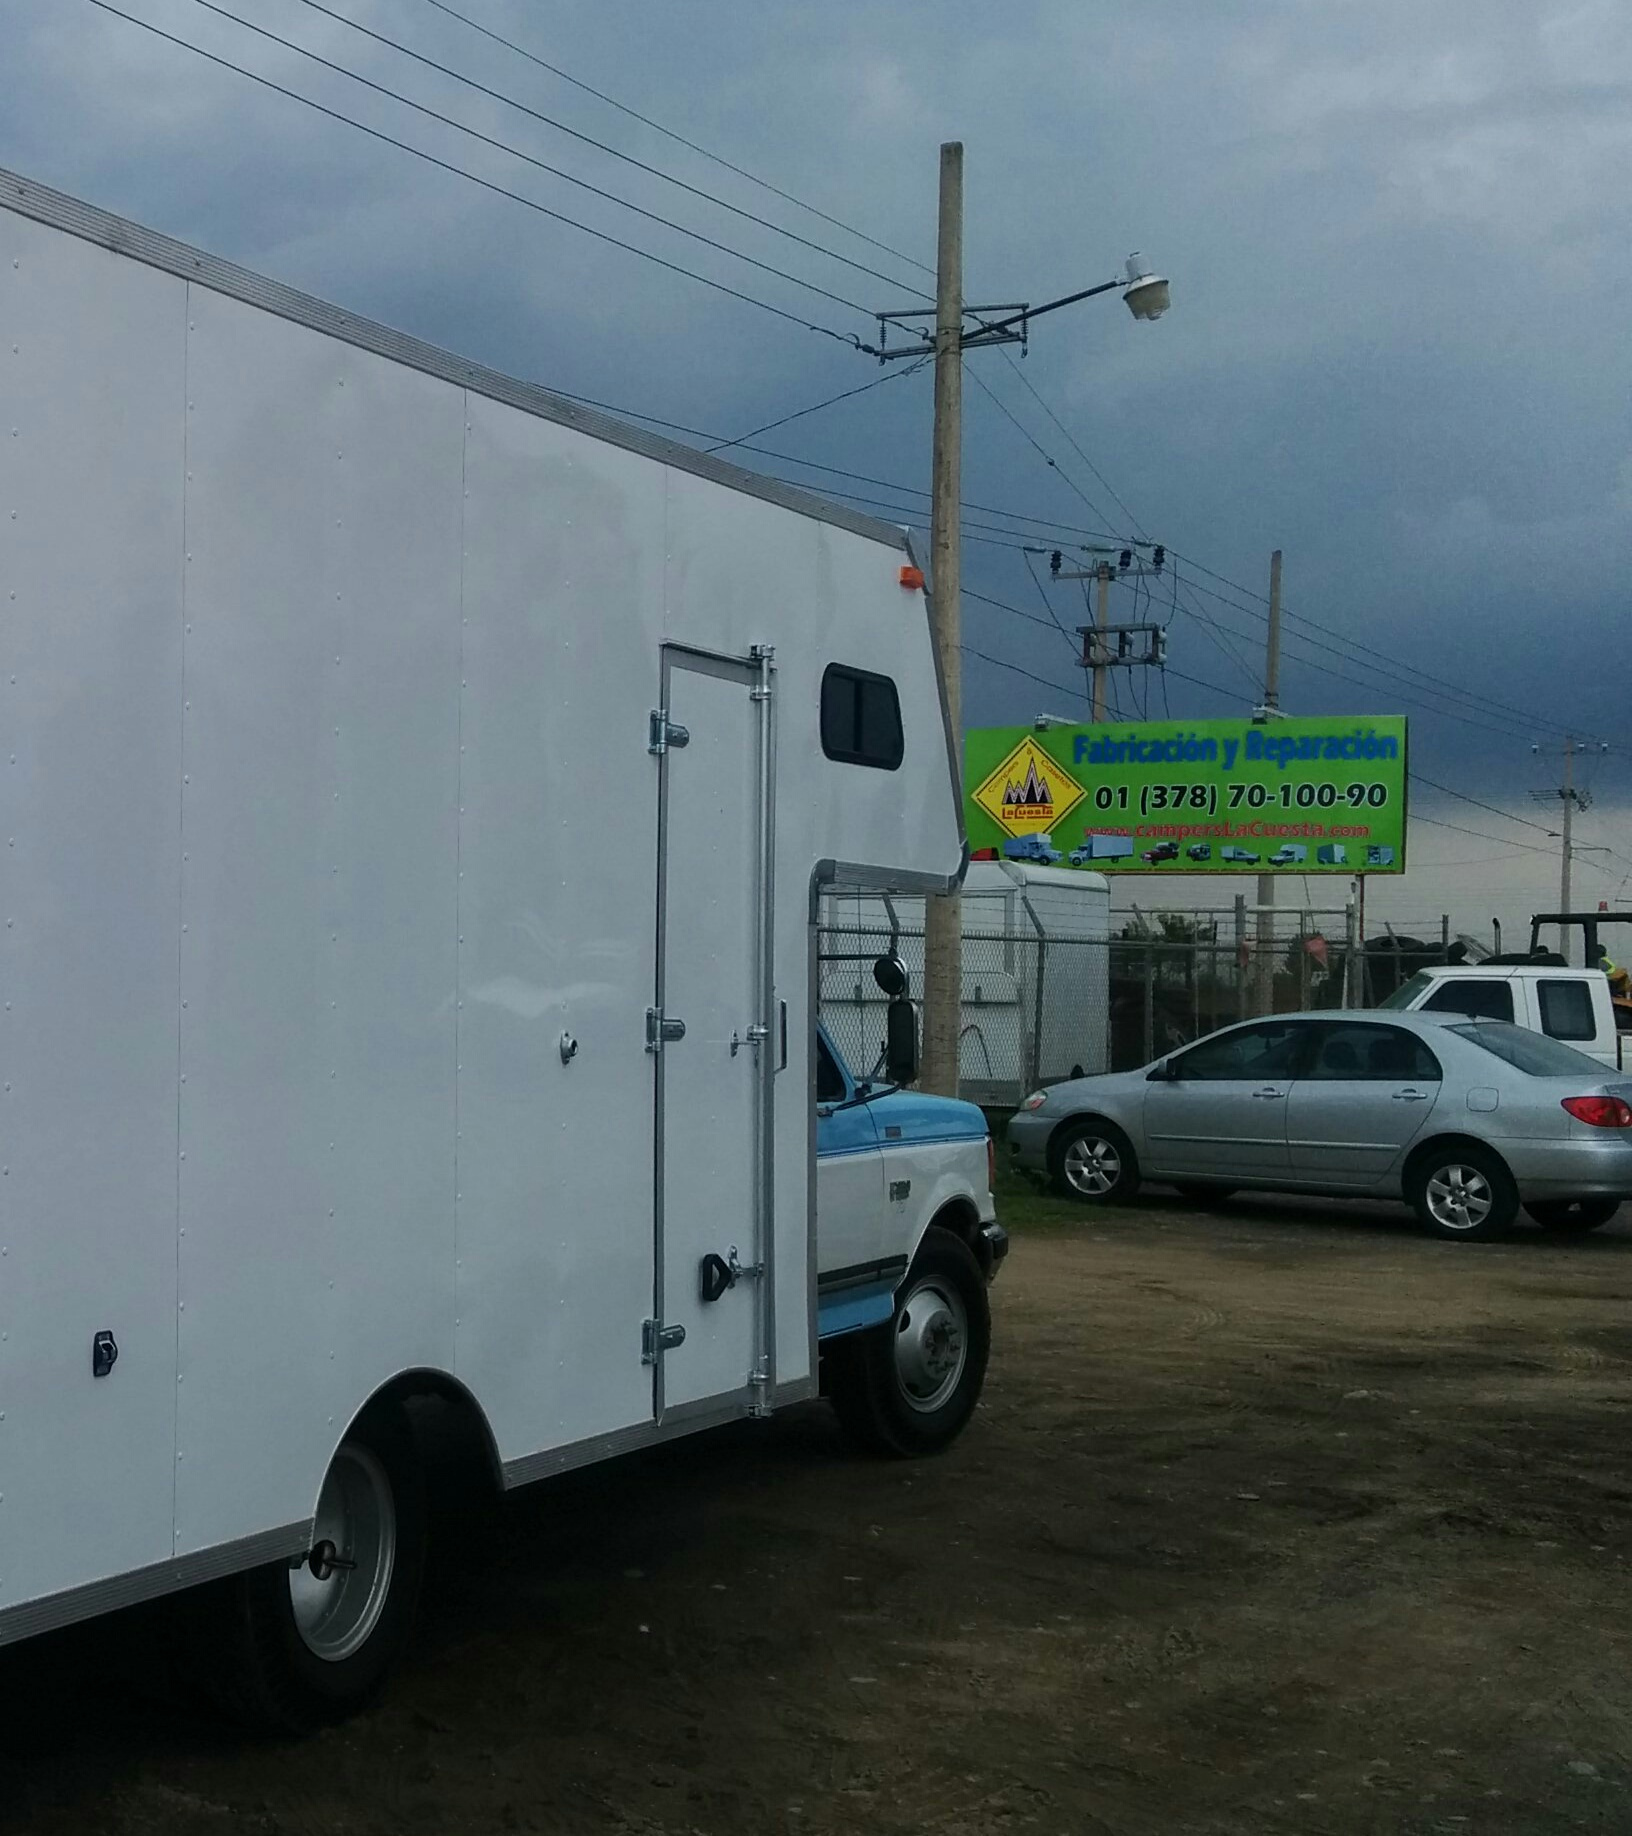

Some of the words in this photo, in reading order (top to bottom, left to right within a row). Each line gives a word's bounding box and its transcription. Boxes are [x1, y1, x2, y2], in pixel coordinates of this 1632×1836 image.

[1073, 733, 1218, 764] Fabricación
[1222, 738, 1239, 770] y
[1245, 729, 1398, 770] Reparación
[1095, 785, 1128, 810] 01
[1140, 784, 1217, 817] (378)
[1227, 782, 1388, 809] 70-100-90
